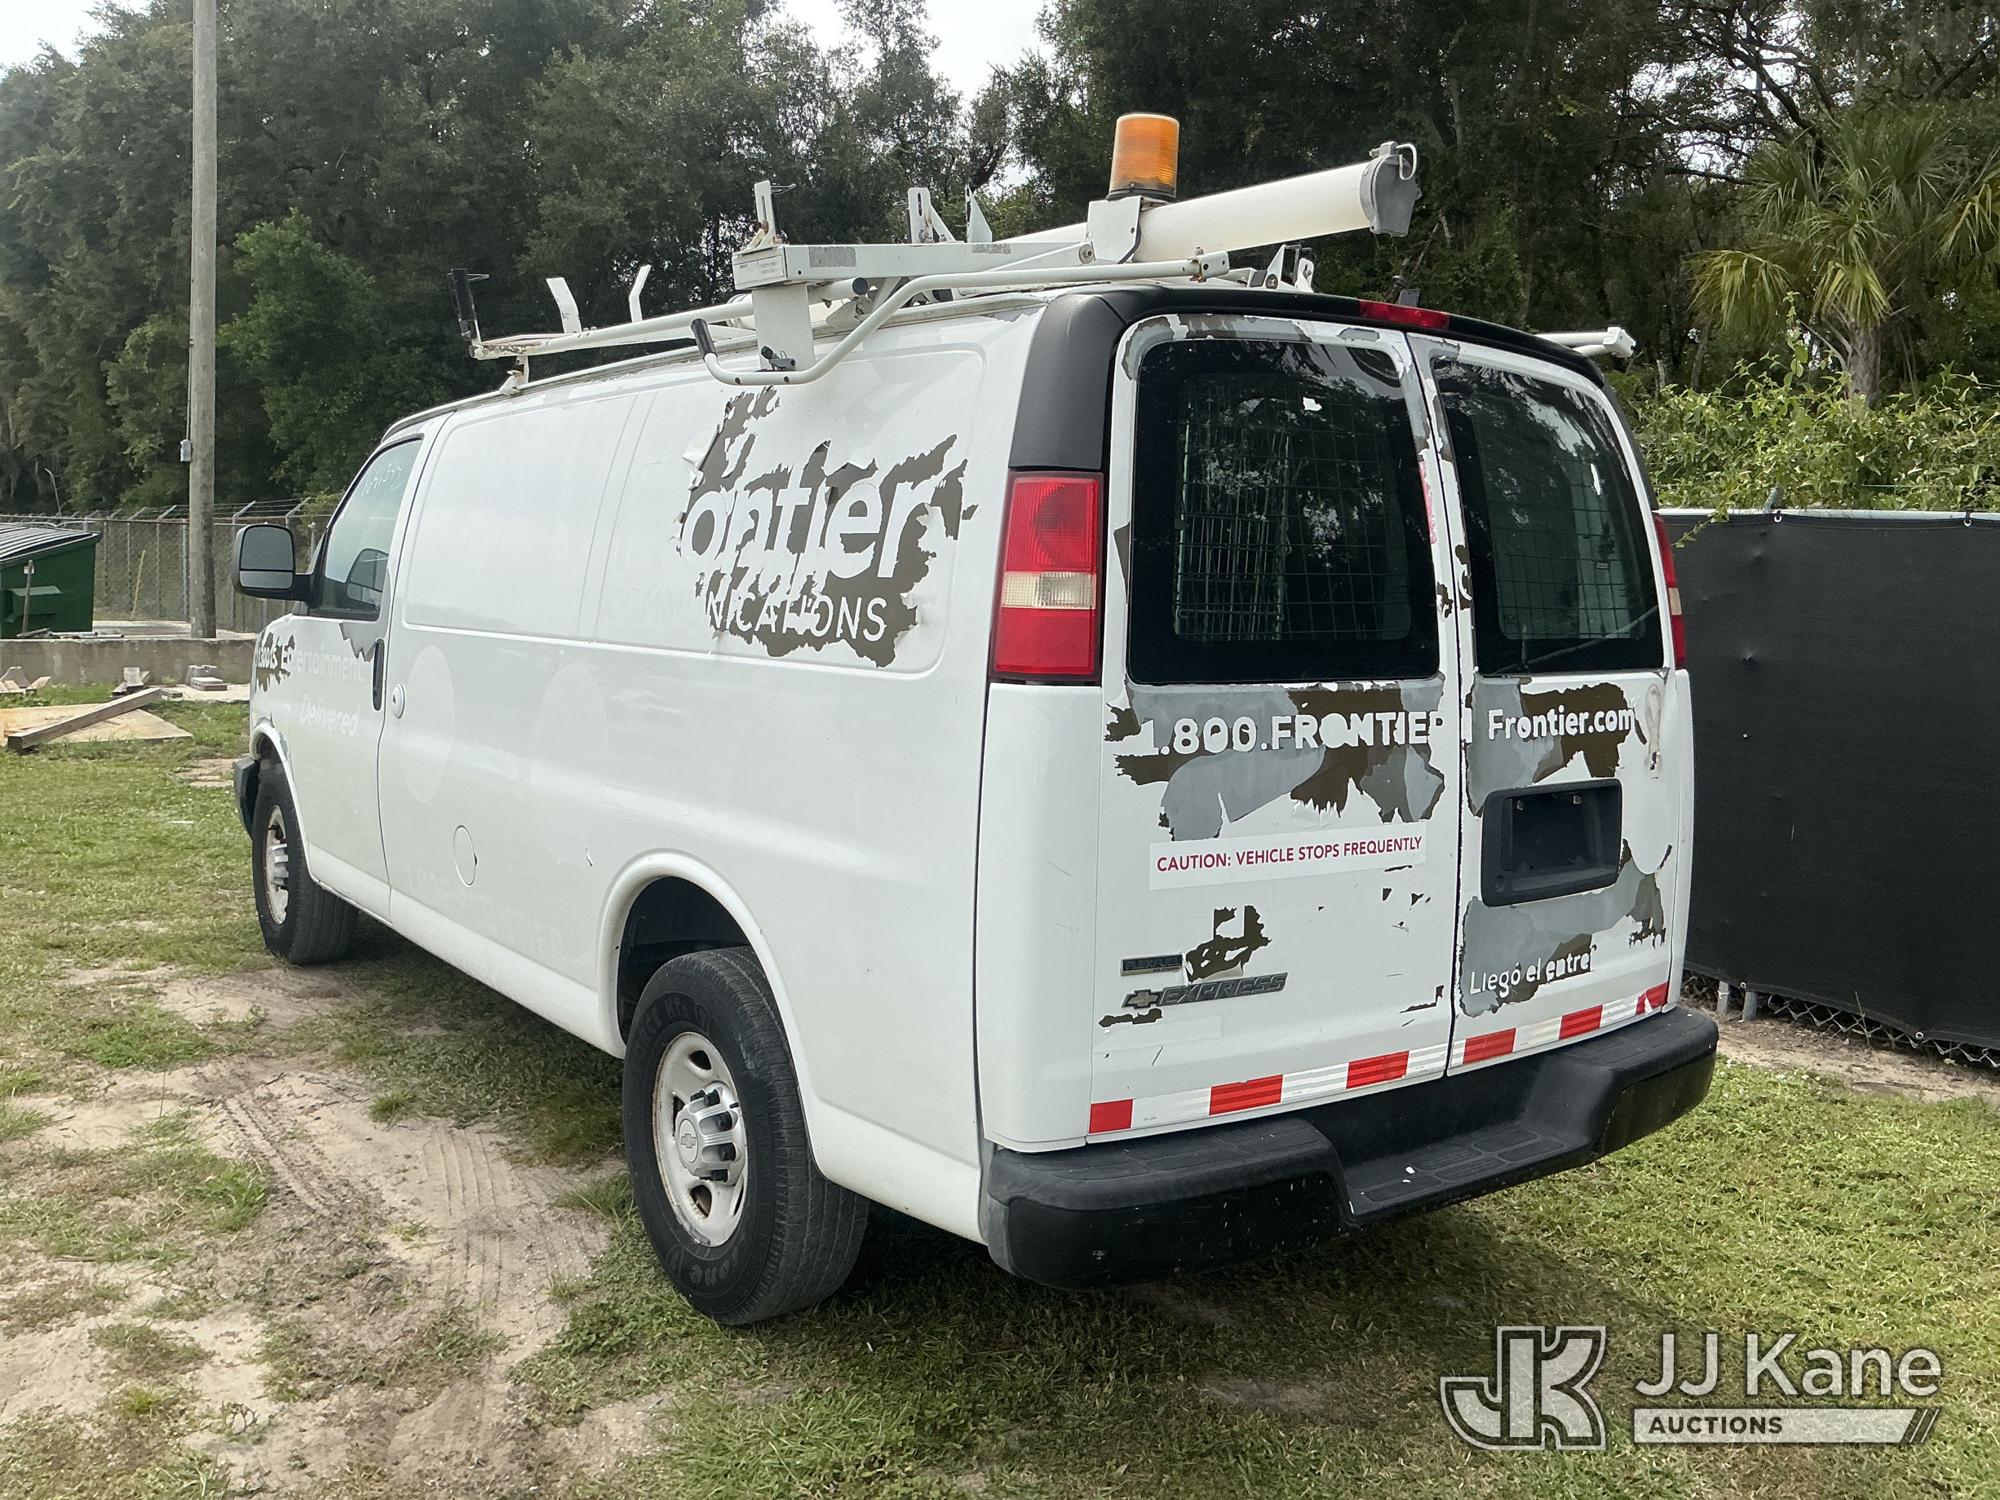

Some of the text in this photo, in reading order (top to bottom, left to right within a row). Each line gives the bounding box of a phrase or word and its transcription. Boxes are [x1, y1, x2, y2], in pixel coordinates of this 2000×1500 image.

[1488, 704, 1636, 740] Frontier.com
[1156, 836, 1423, 872] CAUTION: VEHICLE STOPS FREQUENTLY
[1159, 972, 1288, 1006] EXPRESS
[1469, 961, 1521, 998] Llegó
[1526, 958, 1541, 982] el
